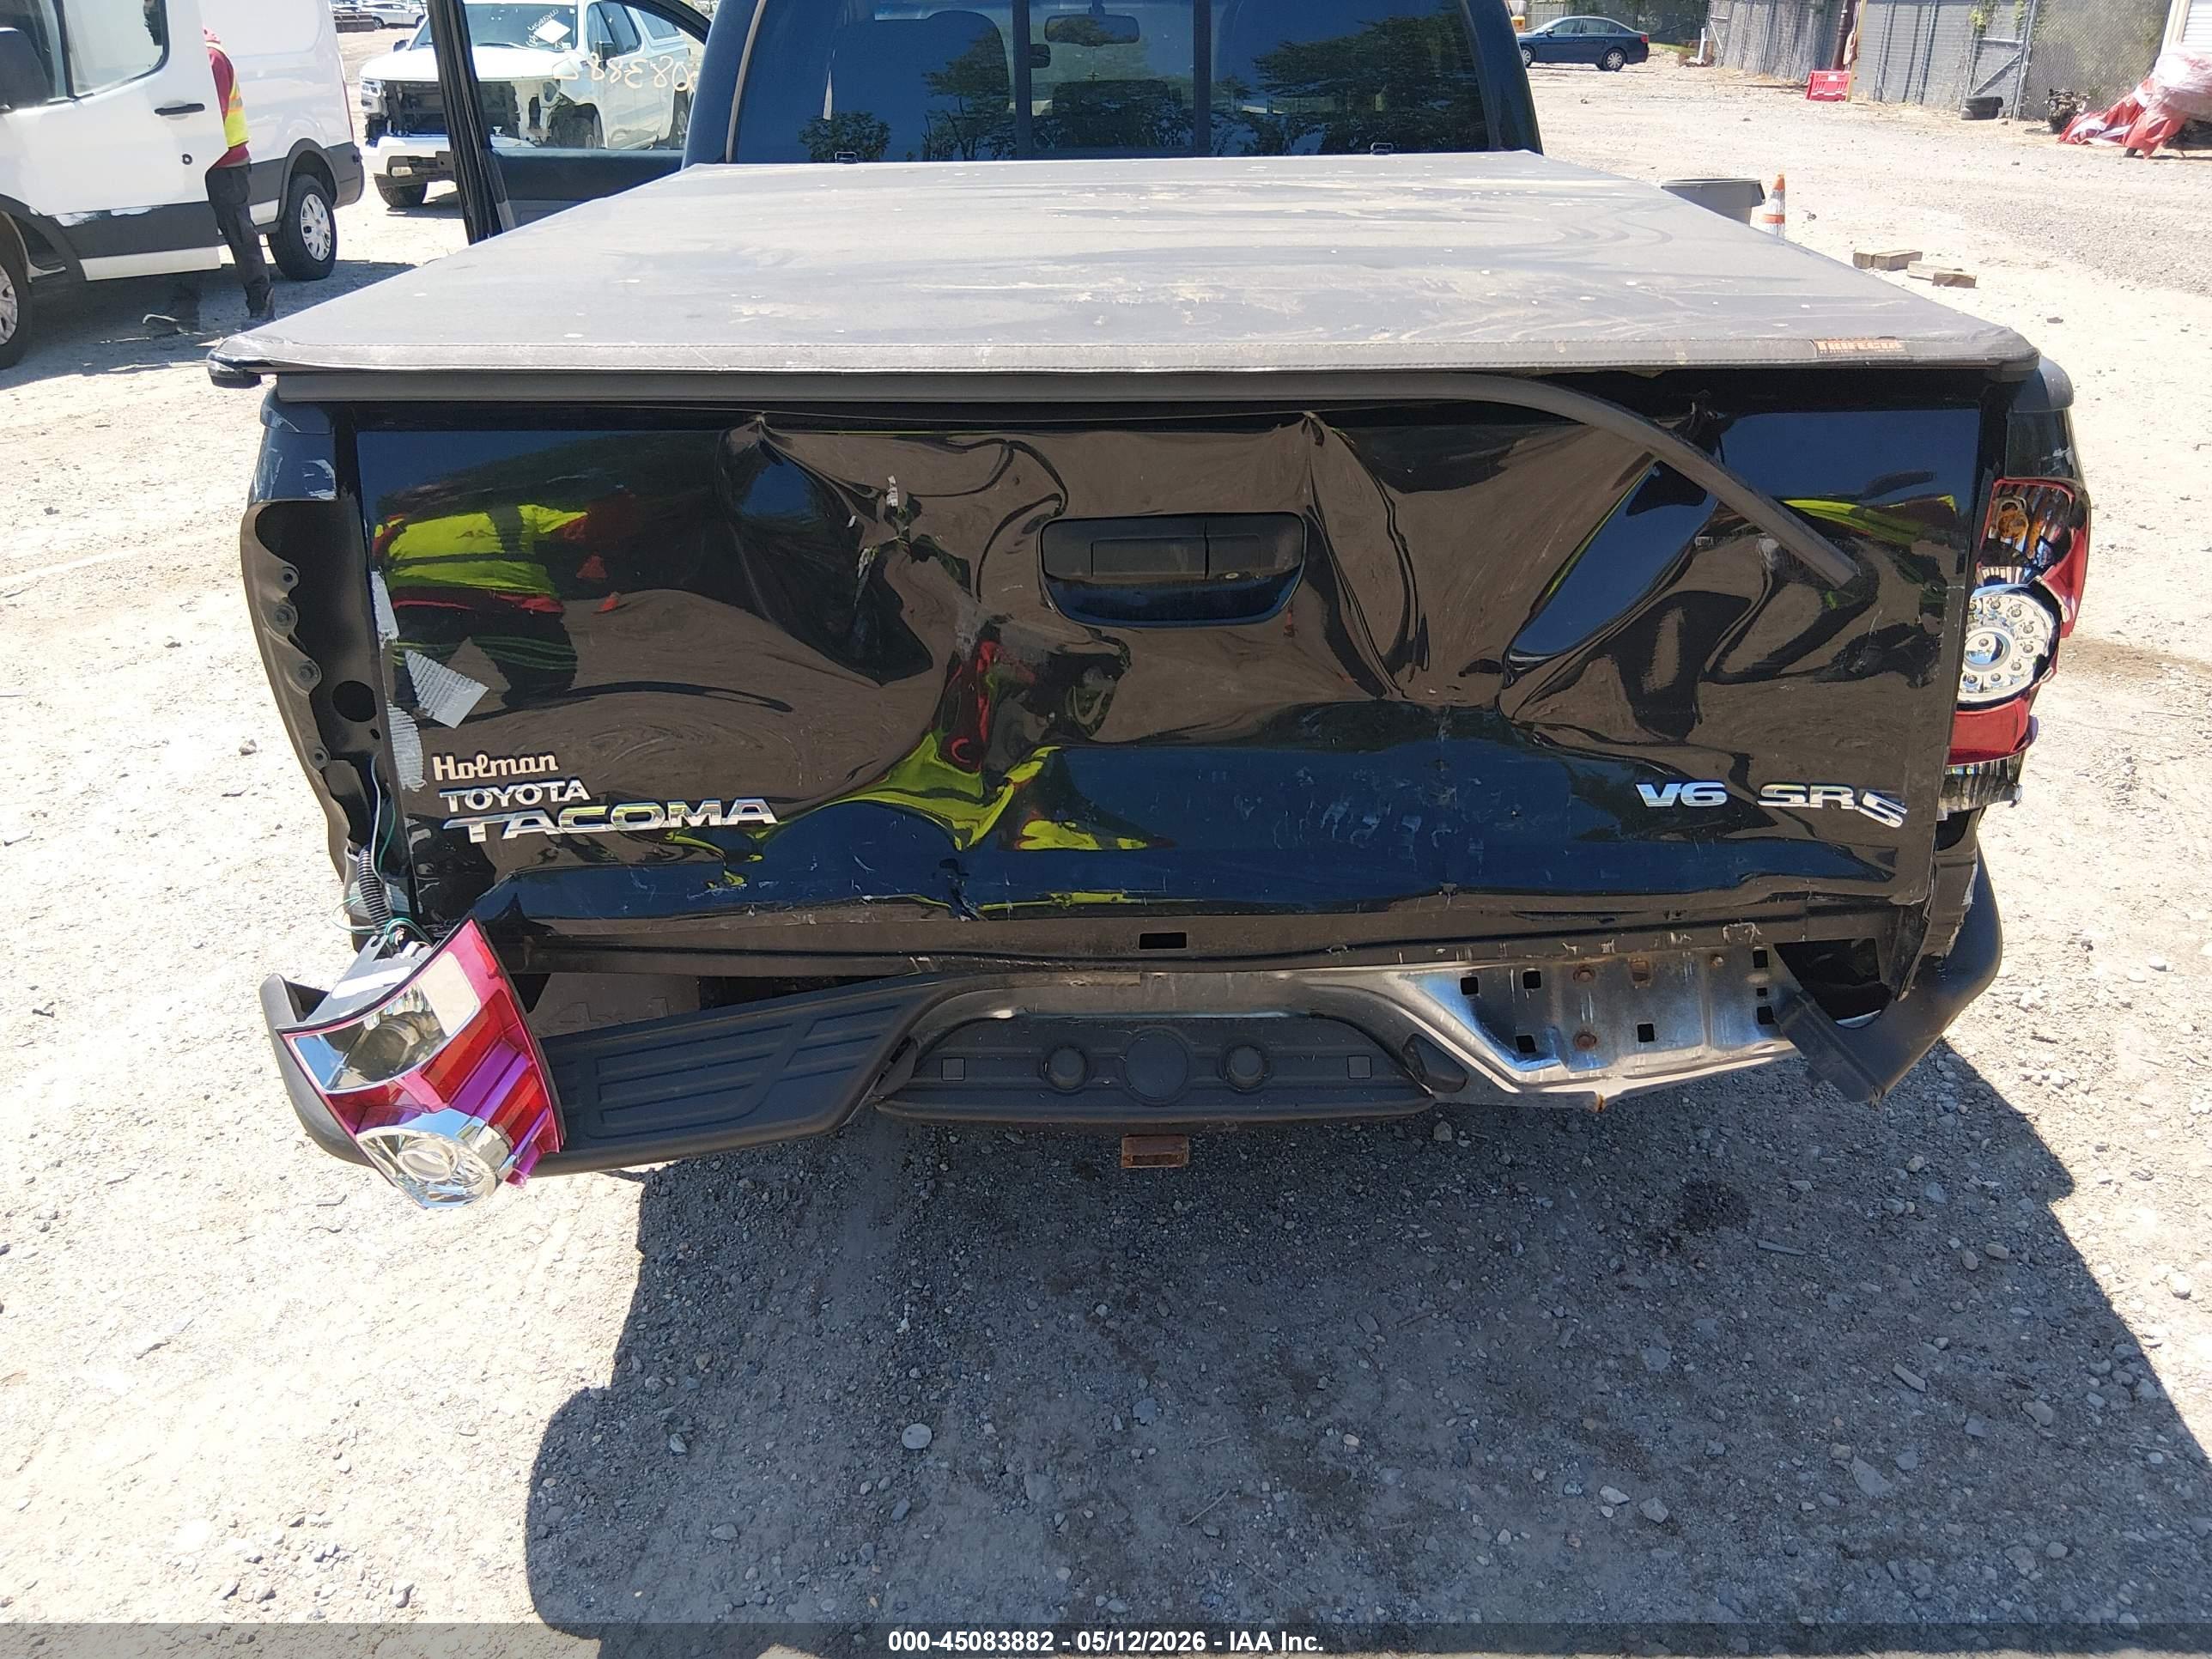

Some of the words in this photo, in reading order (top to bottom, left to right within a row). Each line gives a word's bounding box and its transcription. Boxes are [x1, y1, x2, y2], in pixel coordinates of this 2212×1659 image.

[432, 753, 559, 781] Holman
[439, 779, 592, 813] TOYOTA
[1635, 781, 1728, 807] V6
[1757, 782, 1908, 829] SR5
[442, 798, 779, 844] TACOMA
